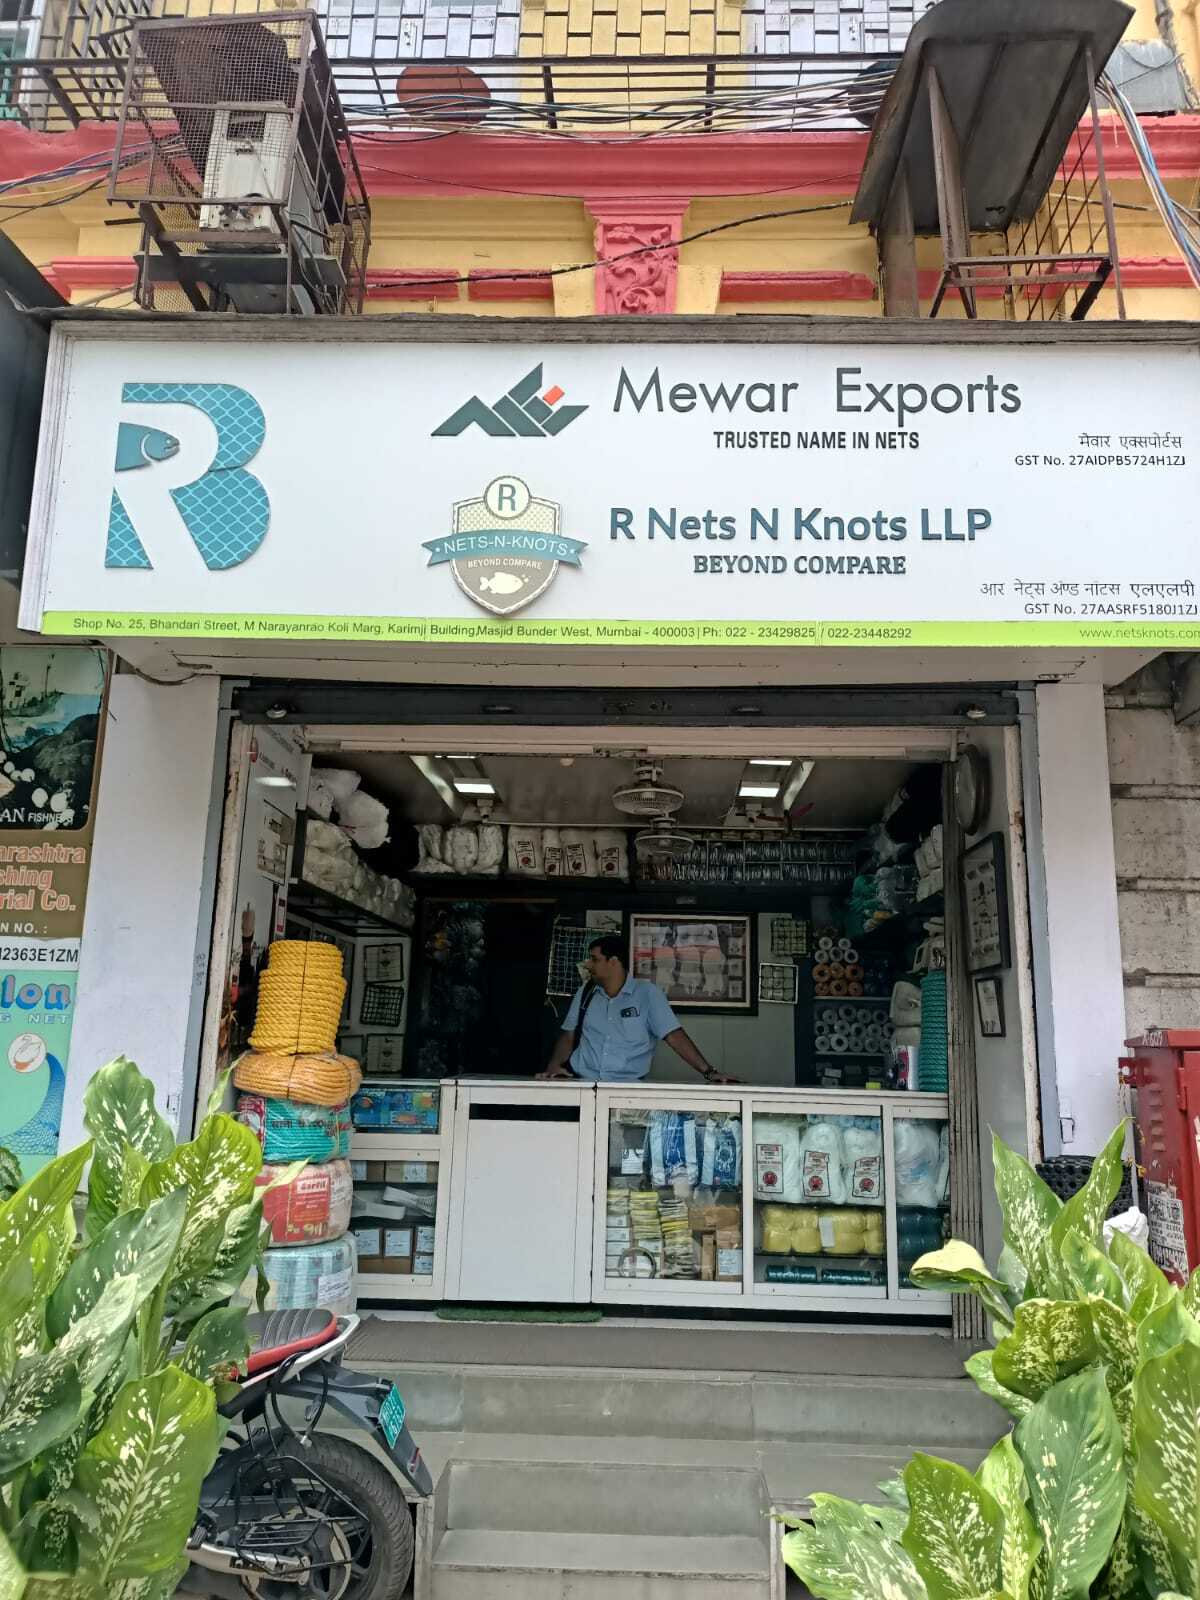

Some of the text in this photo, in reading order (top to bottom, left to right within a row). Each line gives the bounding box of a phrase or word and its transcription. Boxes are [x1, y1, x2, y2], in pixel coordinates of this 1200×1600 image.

[613, 366, 1021, 428] Mewar Exports
[713, 431, 920, 449] TRUSTED NAME IN NETS
[1014, 455, 1039, 466] GST
[1043, 455, 1065, 466] No.
[497, 483, 517, 512] R
[610, 507, 992, 541] R Nets N Knots LLP
[443, 534, 568, 556] NETS-N-KNOTS
[467, 558, 543, 570] BEYOND COMPARE
[693, 555, 906, 575] BEYOND COMPARE
[1024, 603, 1049, 615] GST
[1053, 603, 1076, 615] No.
[73, 618, 102, 630] Shop
[106, 618, 124, 629] No.
[128, 619, 146, 630] 25,
[150, 619, 200, 631] Bhandari
[204, 620, 240, 632] Street,
[244, 621, 255, 631] M
[258, 621, 324, 634] Narayanrao
[328, 622, 349, 633] Koli
[353, 623, 384, 635] Marg,
[517, 626, 557, 636] Bunder
[597, 627, 641, 637] Mumbai
[652, 627, 695, 638] 400003
[725, 627, 747, 638] 022
[758, 627, 815, 638] 23429825
[827, 627, 912, 639] 022-23448292
[41, 889, 76, 911] Co.
[14, 921, 38, 934] NO.
